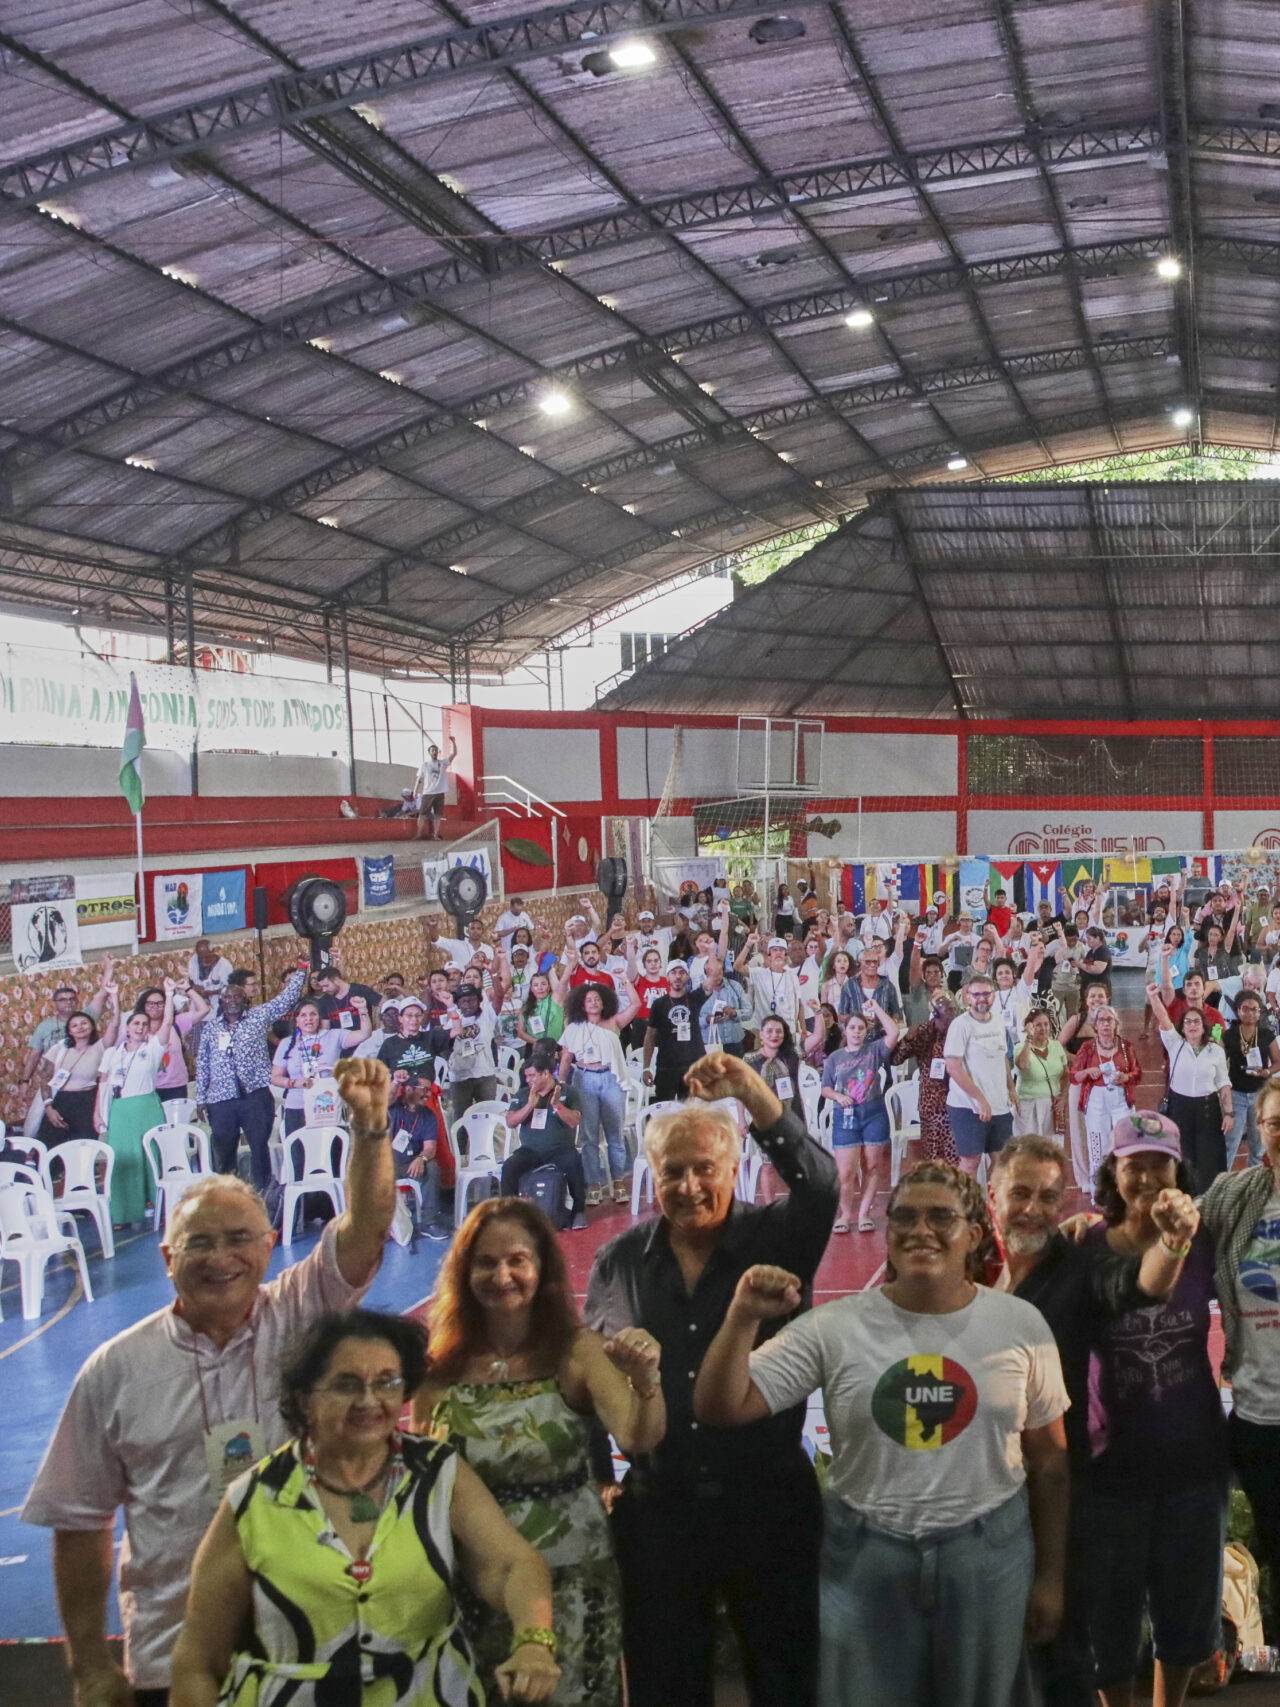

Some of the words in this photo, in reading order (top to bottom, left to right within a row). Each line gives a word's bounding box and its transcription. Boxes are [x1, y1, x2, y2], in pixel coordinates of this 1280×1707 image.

[1043, 824, 1092, 838] Colégio
[77, 899, 135, 914] OTROS
[905, 1386, 953, 1403] UNE
